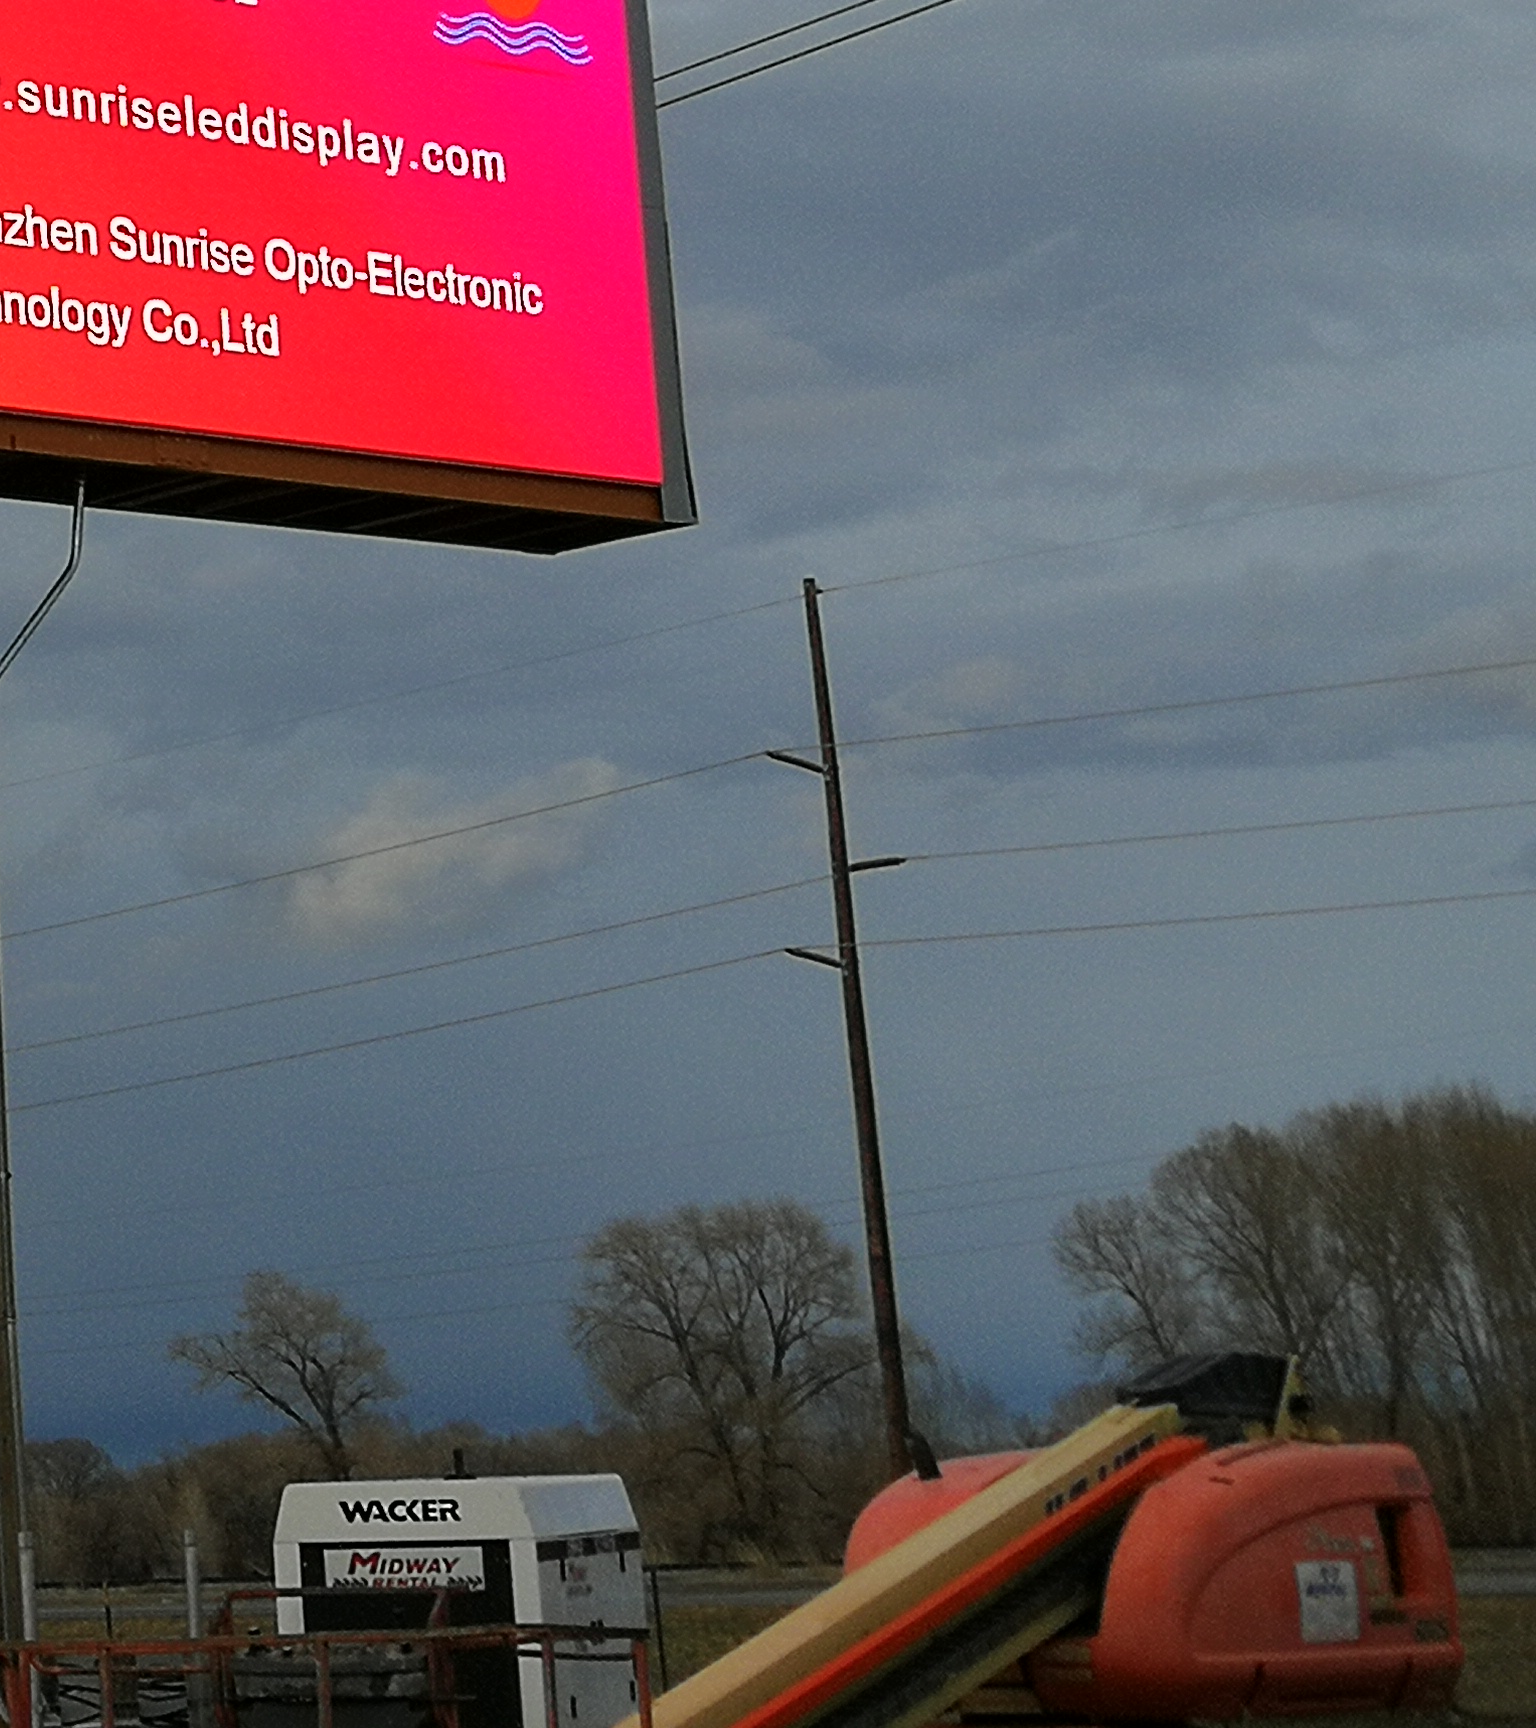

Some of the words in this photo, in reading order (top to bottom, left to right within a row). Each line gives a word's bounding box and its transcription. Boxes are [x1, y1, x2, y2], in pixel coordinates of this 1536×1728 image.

[109, 215, 255, 277] Sunrise
[264, 237, 544, 316] Opto-Electronic
[142, 298, 280, 358] Co.,Ltd
[338, 1498, 462, 1523] WACKER
[347, 1551, 461, 1575] MIDWAY
